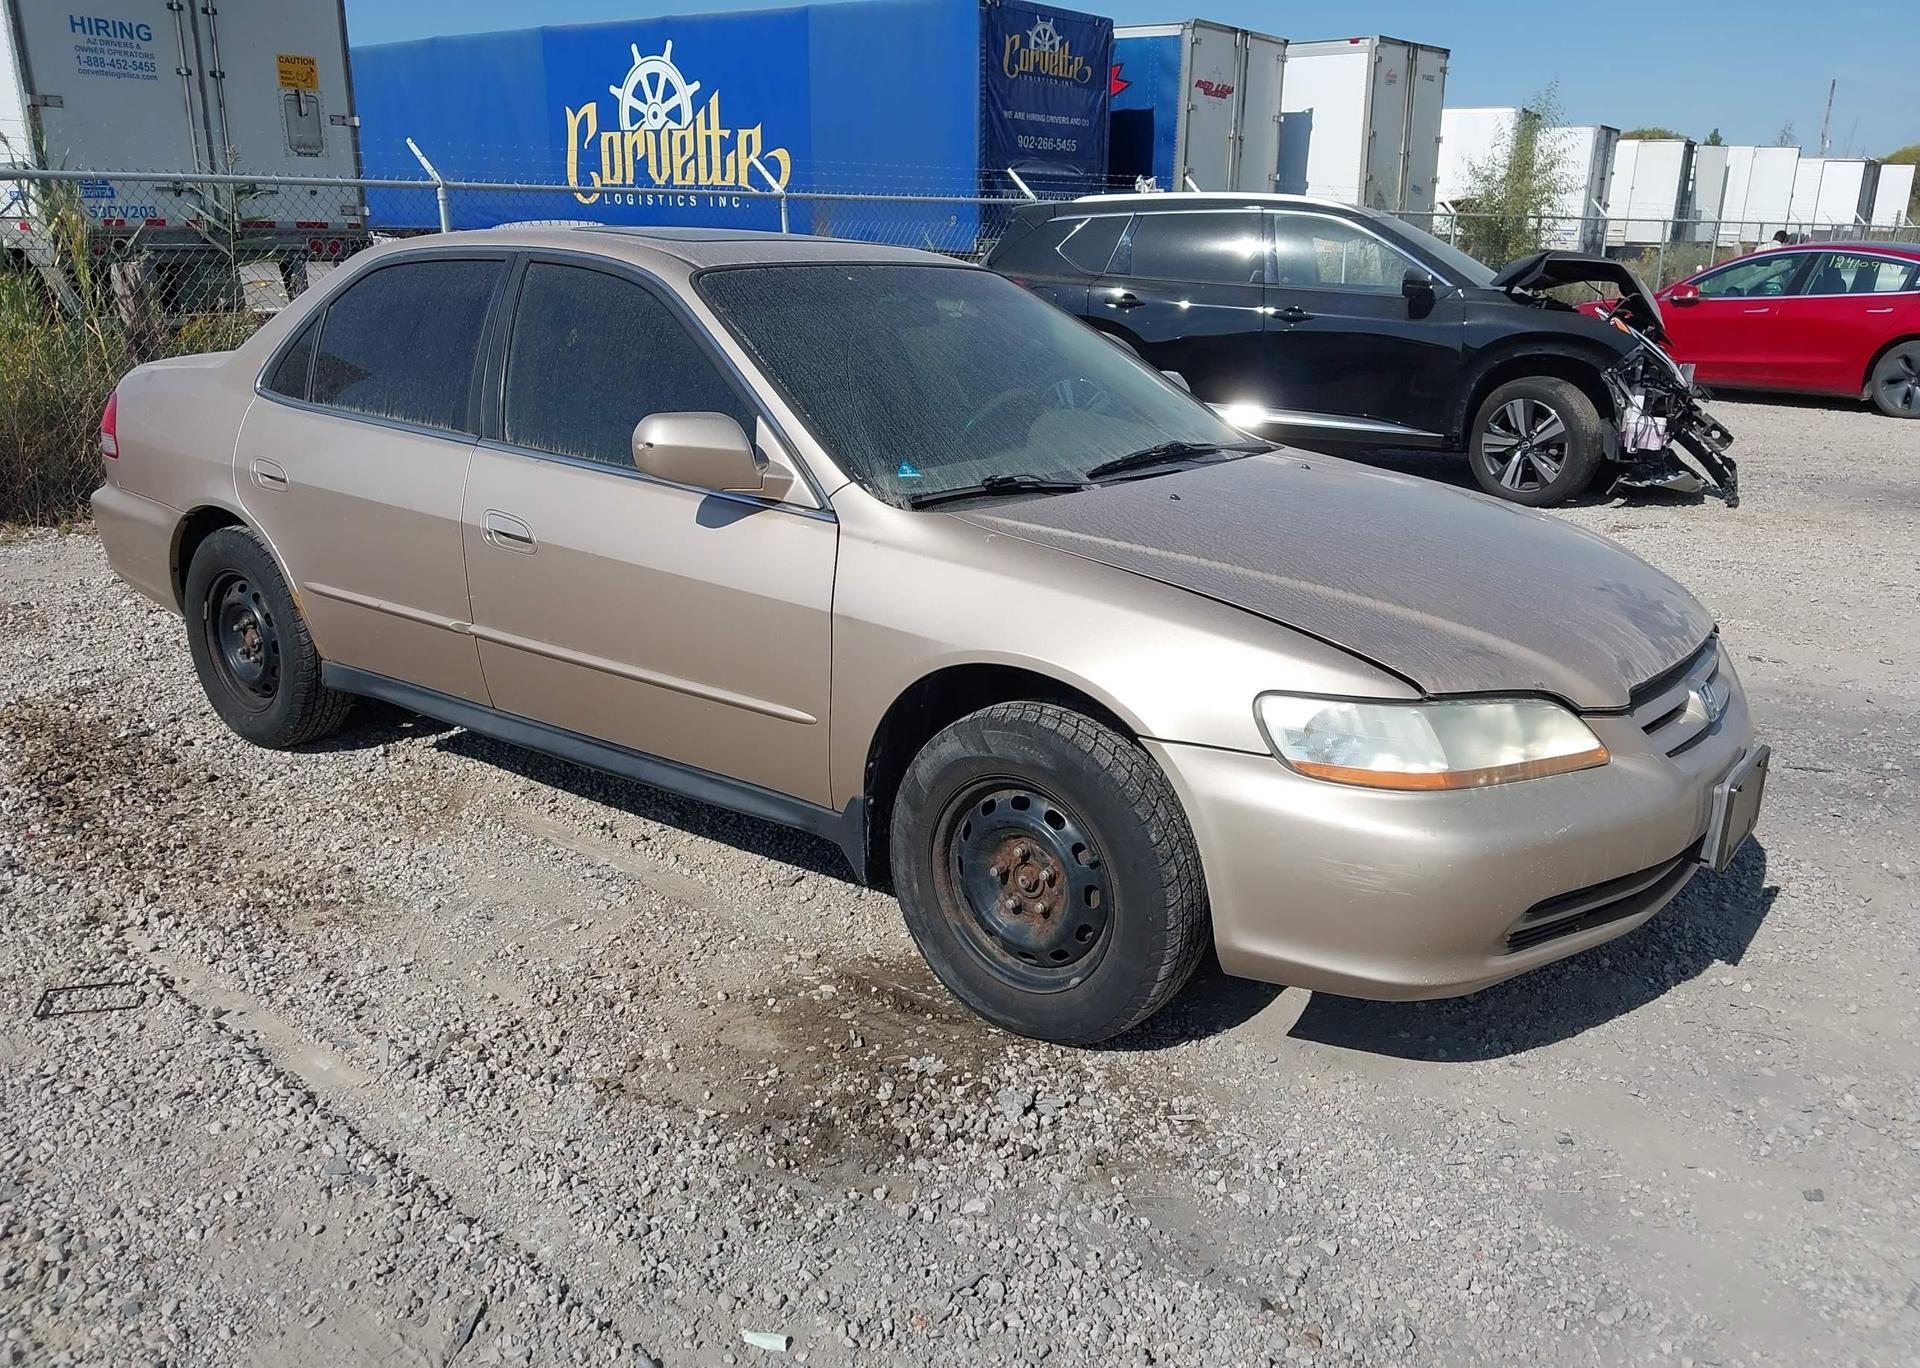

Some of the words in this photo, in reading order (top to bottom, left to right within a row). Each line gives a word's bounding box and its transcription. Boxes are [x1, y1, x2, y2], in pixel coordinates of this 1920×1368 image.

[69, 14, 153, 42] HIRING
[99, 39, 134, 50] DRIVERS
[74, 45, 105, 55] OWNER
[107, 48, 155, 60] OPERATORS
[76, 54, 156, 73] 1-888-452-5455
[278, 55, 315, 66] CAUTION
[78, 68, 158, 81] corvettelogistics.com
[1195, 79, 1214, 91] RED
[1003, 110, 1013, 119] WE
[1014, 111, 1025, 120] ARE
[1026, 112, 1046, 122] HIRING
[1047, 115, 1070, 125] DRIVERS
[1070, 117, 1081, 126] AND
[565, 89, 791, 204] Corvette
[1017, 134, 1077, 152] 902-266-5455
[604, 193, 697, 207] LOGISTICS
[709, 196, 750, 208] INC.
